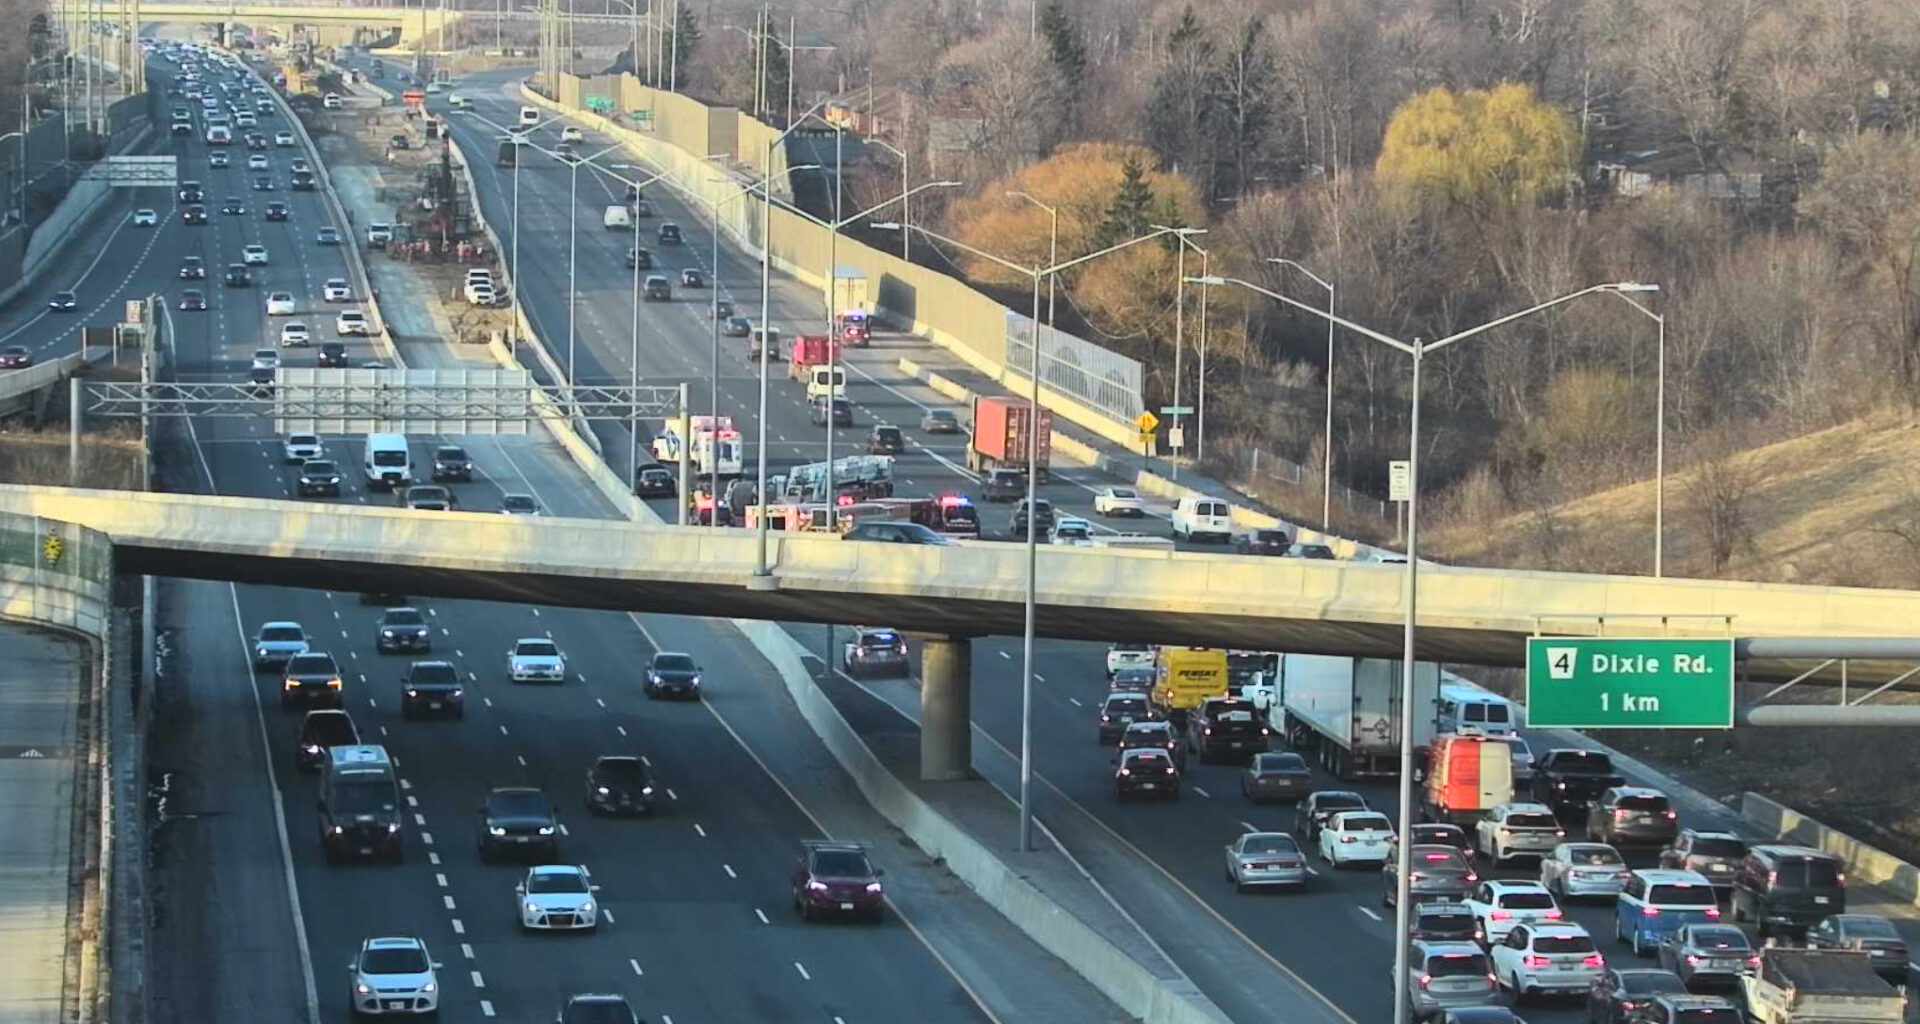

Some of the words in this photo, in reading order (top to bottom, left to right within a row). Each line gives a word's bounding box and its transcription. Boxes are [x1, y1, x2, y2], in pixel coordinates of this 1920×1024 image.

[1554, 653, 1569, 673] 4
[1592, 654, 1660, 673] Dixie
[1673, 654, 1714, 673] Rd.
[1601, 692, 1609, 712] 1
[1623, 692, 1659, 712] km
